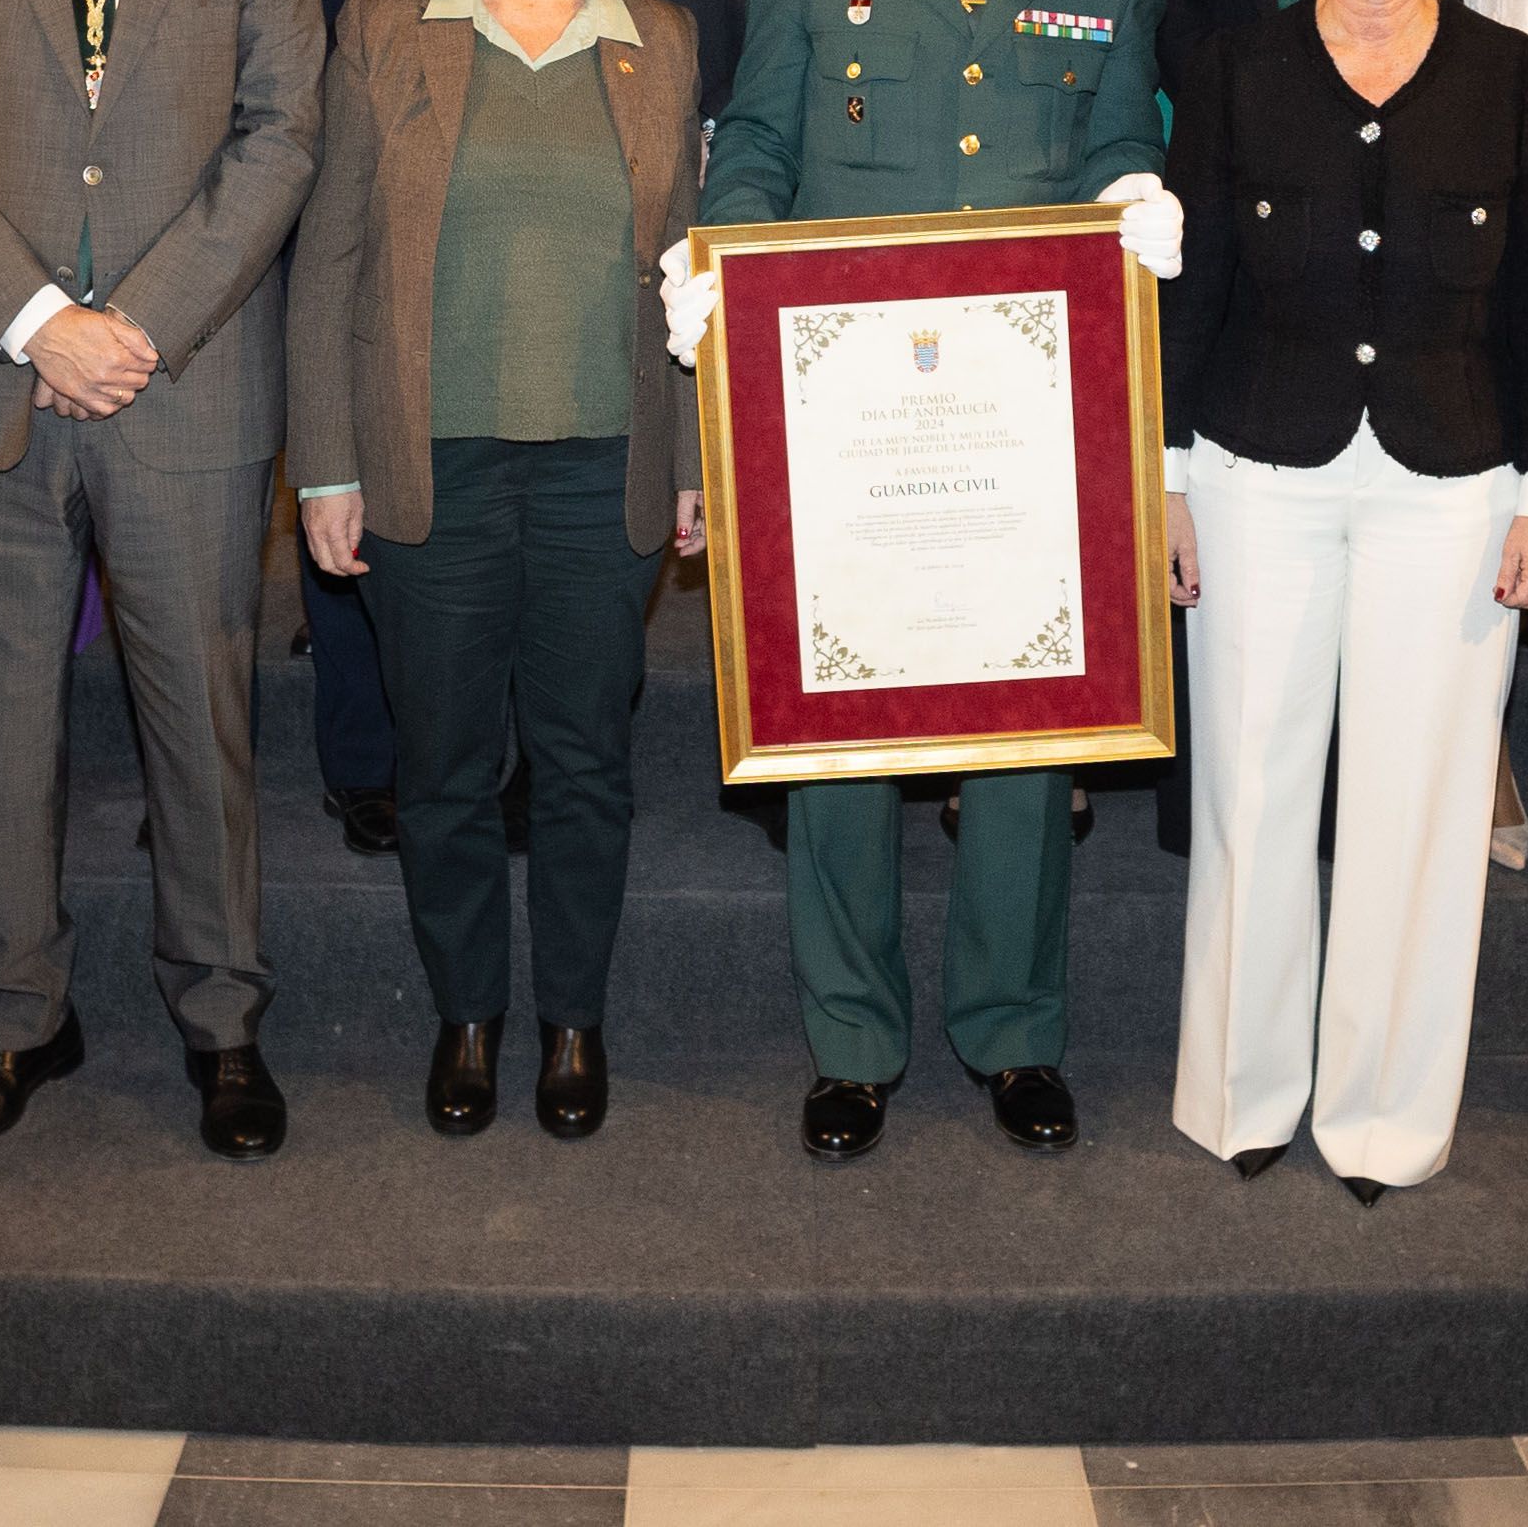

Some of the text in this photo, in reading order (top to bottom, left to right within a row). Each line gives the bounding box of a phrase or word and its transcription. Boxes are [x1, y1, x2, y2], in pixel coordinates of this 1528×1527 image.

[901, 392, 956, 406] PREMIO
[891, 408, 909, 419] DE
[913, 402, 998, 418] ANDALUCÍA
[915, 419, 944, 430] 2024
[870, 436, 884, 446] LA
[886, 434, 908, 445] MUY
[912, 432, 946, 444] NOBLE
[960, 430, 983, 440] MUY
[839, 439, 1025, 459] CIUDAD DE JEREZ DE LA FRONTERA
[904, 465, 938, 477] FAVOR
[941, 464, 955, 474] DE
[959, 463, 972, 473] LA
[869, 478, 1000, 499] GUARDIA CIVIL
